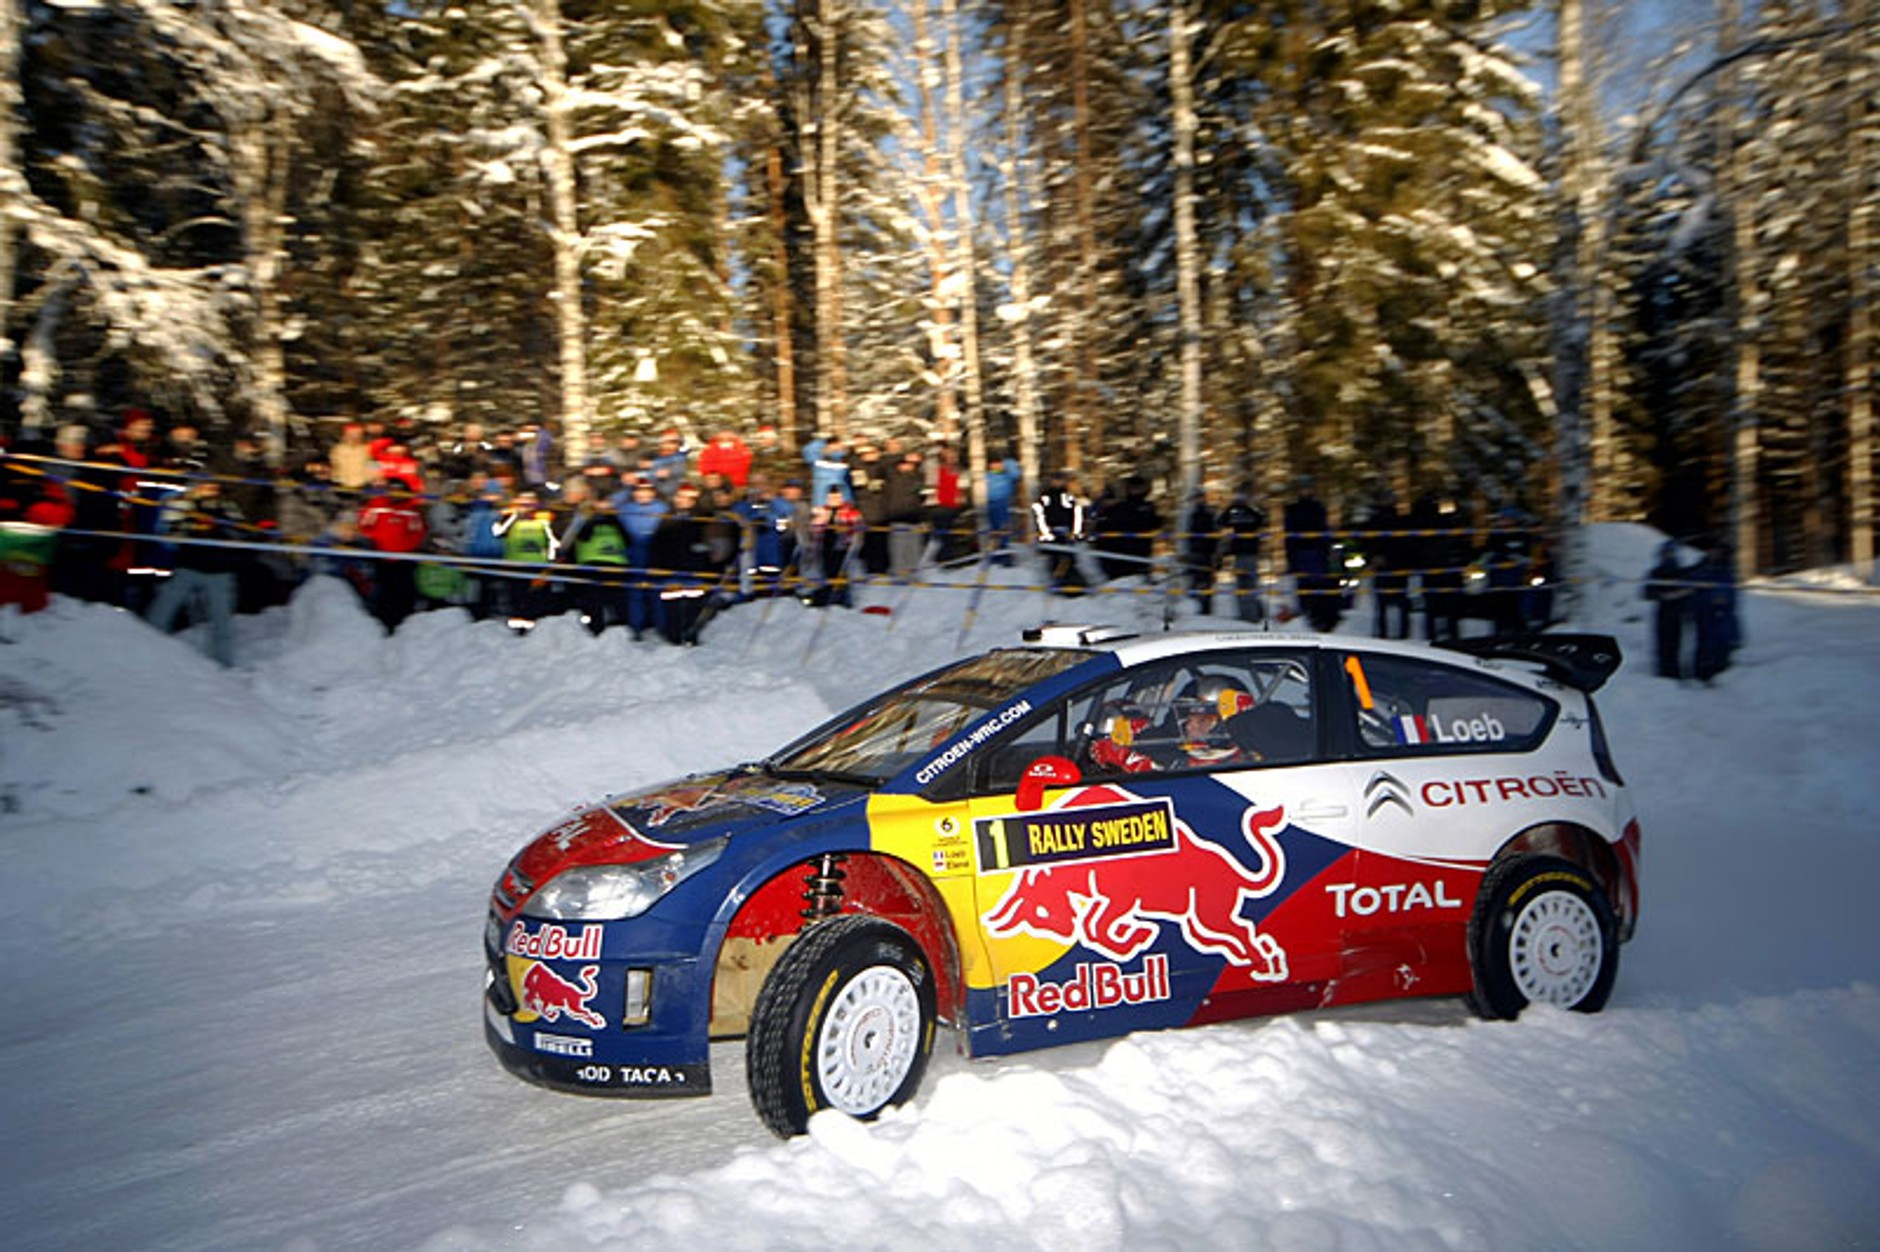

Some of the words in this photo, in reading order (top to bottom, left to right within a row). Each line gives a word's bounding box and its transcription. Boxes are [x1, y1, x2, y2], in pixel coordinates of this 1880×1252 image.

[1345, 655, 1374, 709] 1
[916, 700, 1032, 784] CITROEN-WRC.COM
[1431, 713, 1505, 743] Loeb
[988, 819, 1010, 869] 1
[1027, 822, 1086, 855] RALLY
[1091, 810, 1168, 849] SWEDEN
[1325, 880, 1462, 918] TOTAL
